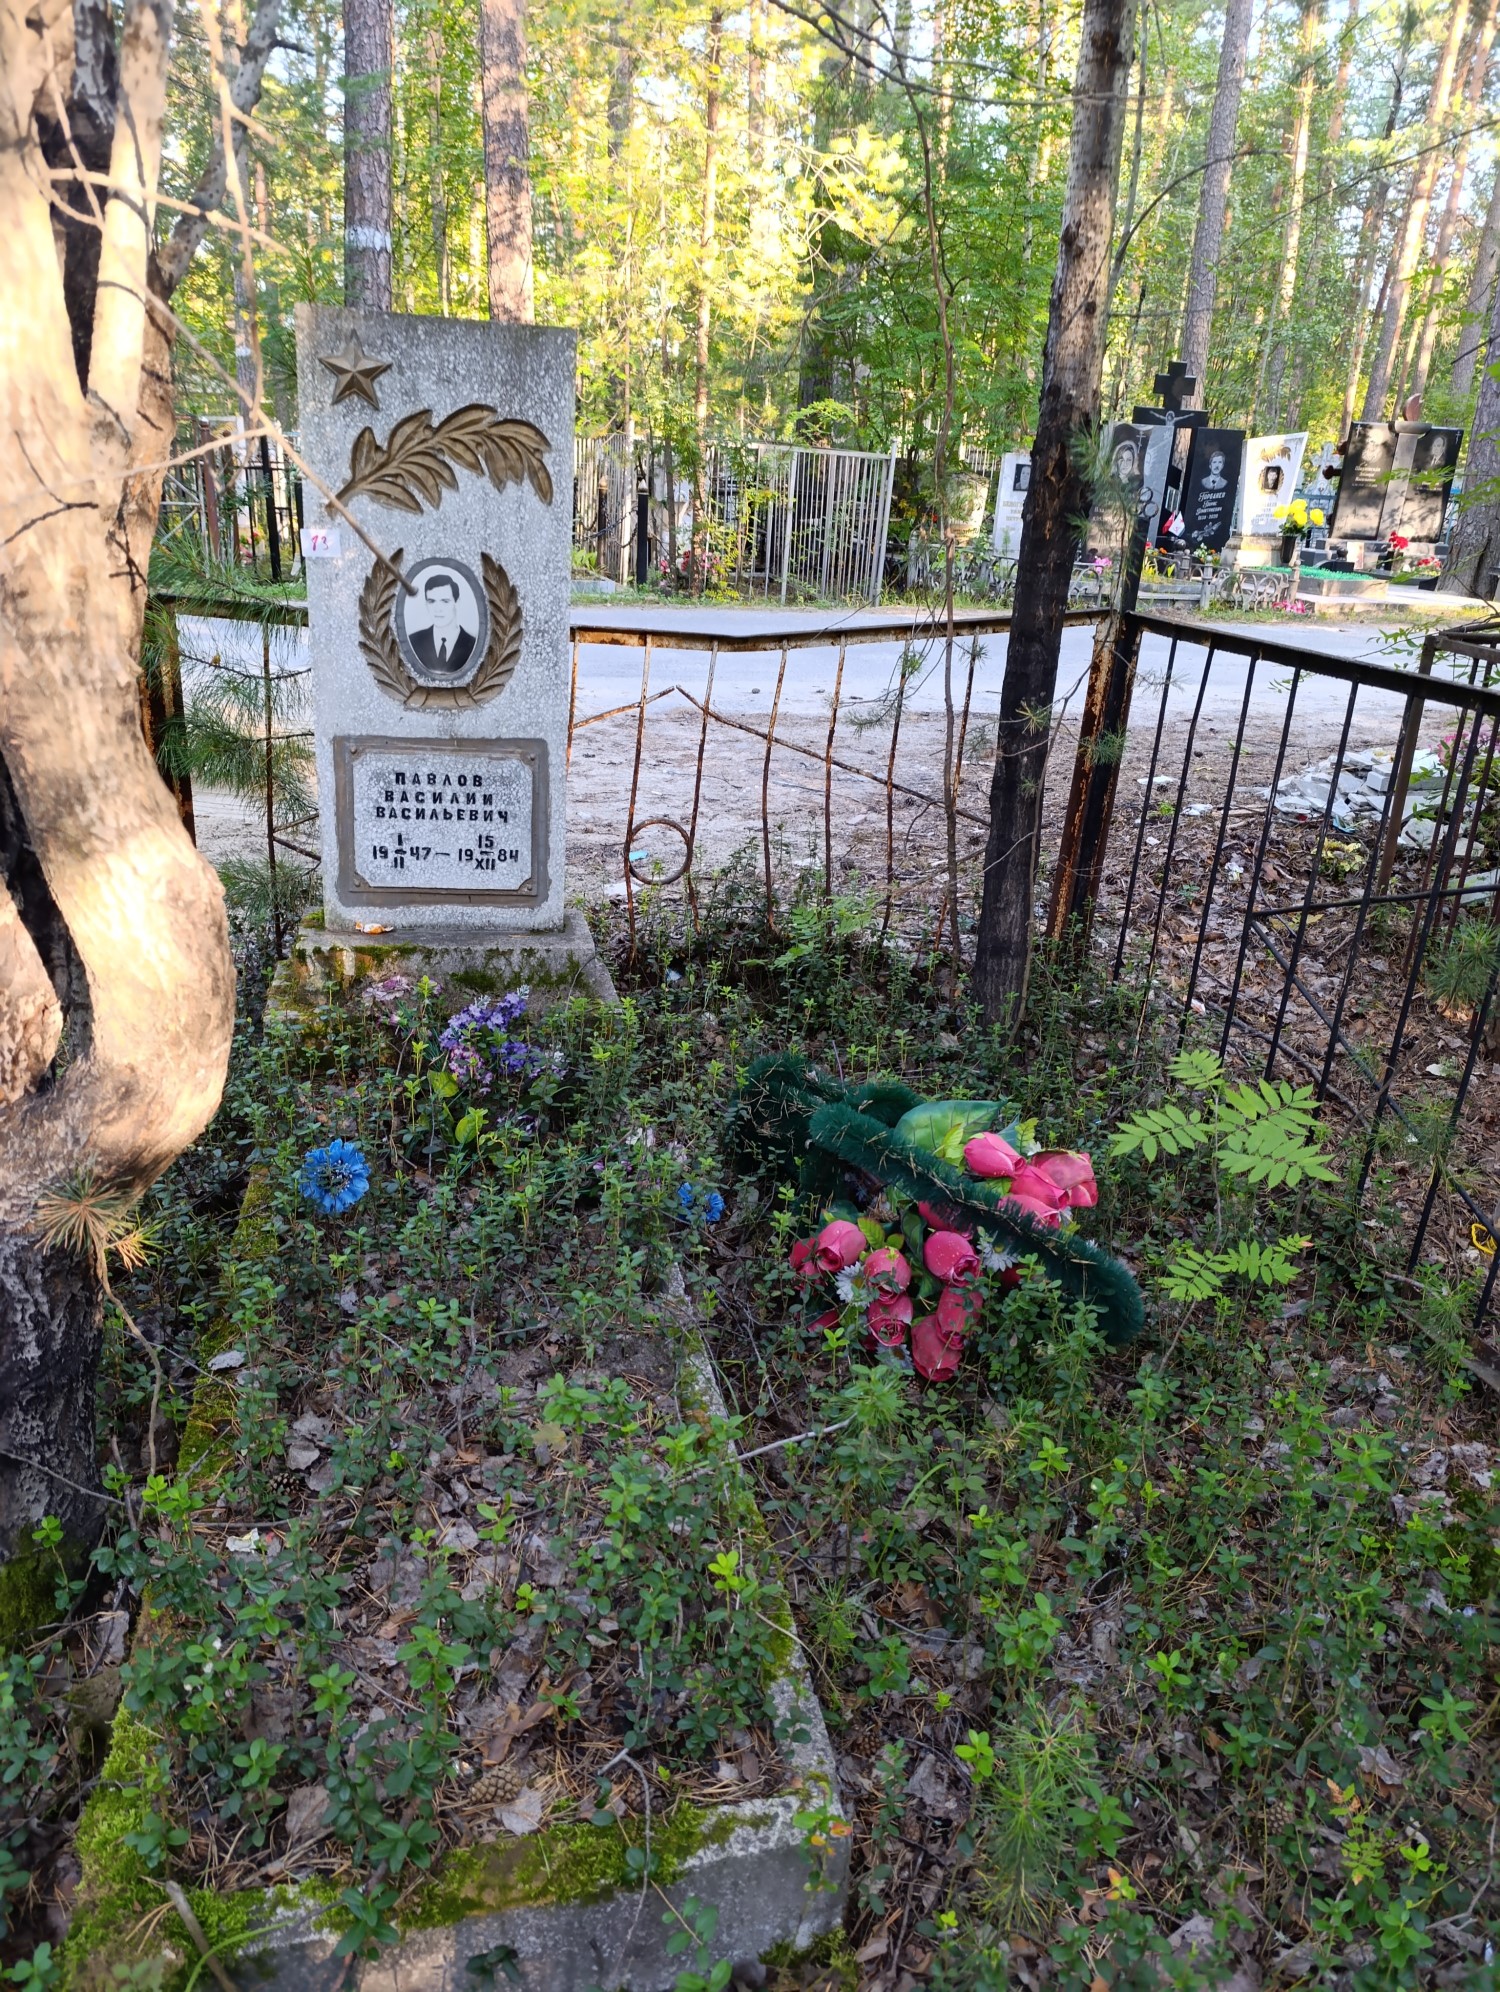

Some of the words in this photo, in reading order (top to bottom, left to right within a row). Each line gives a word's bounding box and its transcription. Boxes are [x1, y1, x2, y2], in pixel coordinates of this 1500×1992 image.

[395, 772, 483, 788] ПАВЛОВ
[376, 806, 508, 824] ВАСИЛЬЕВИЧ
[478, 834, 494, 849] 15
